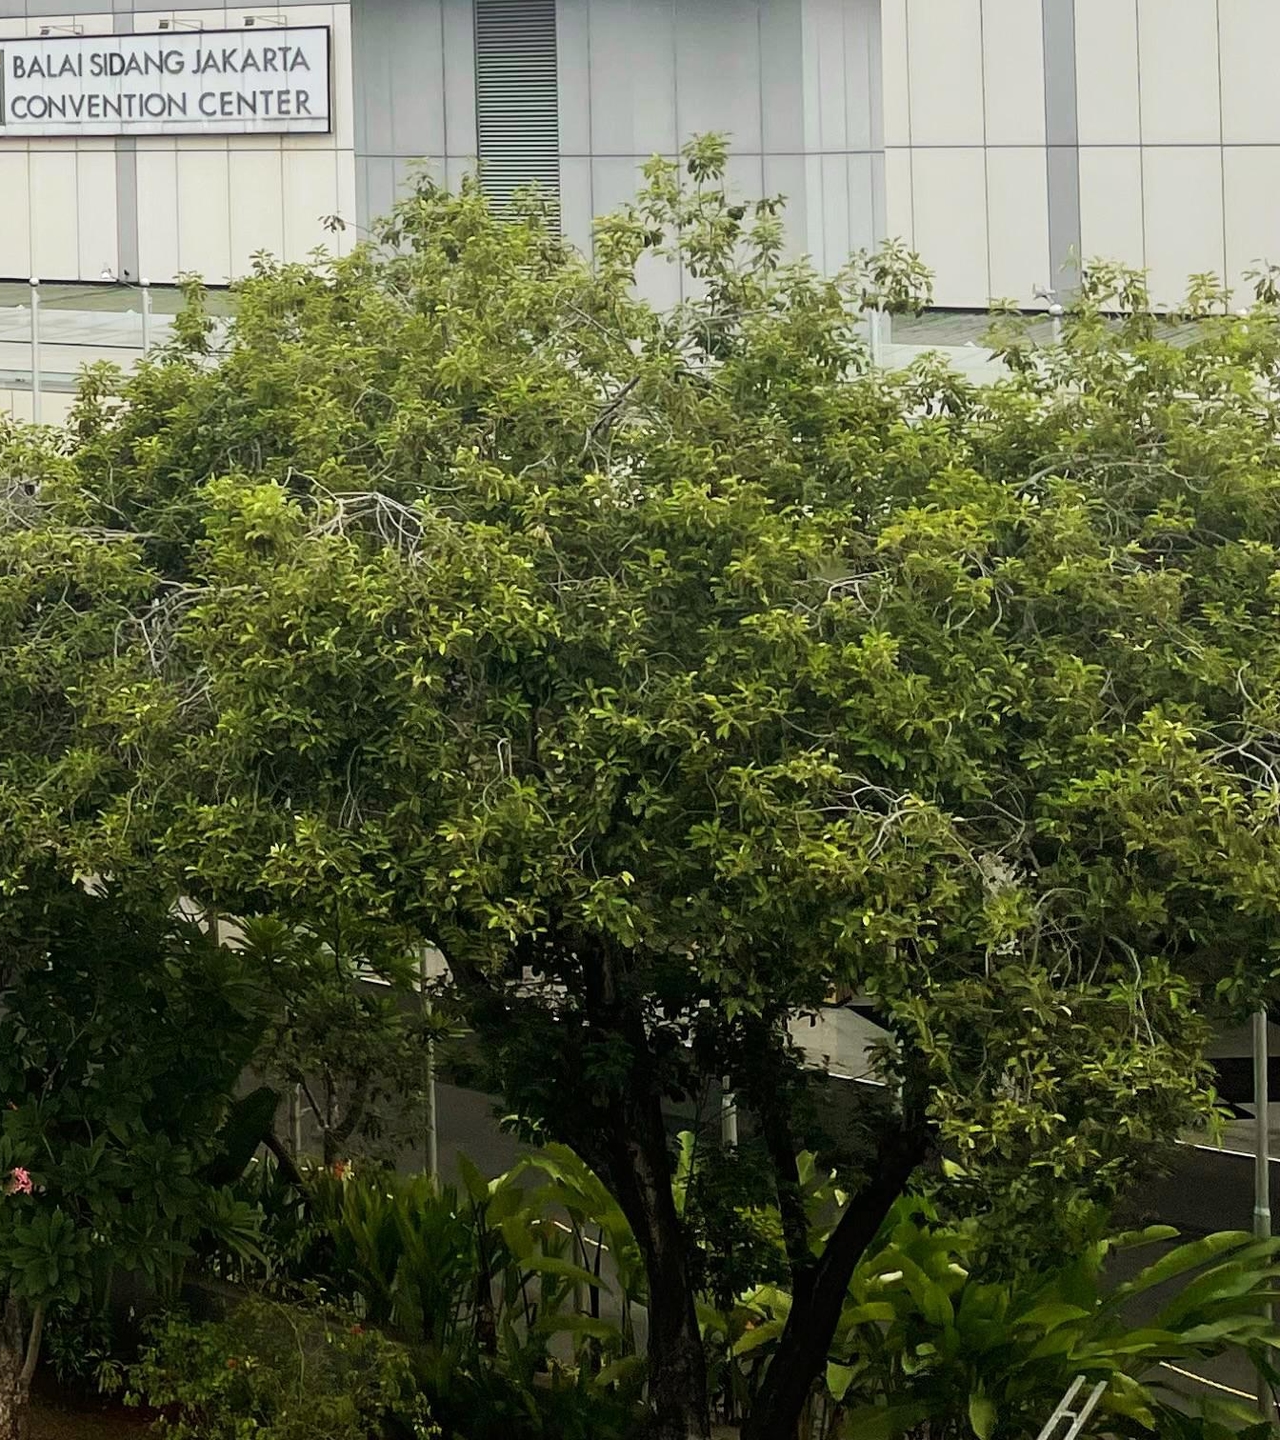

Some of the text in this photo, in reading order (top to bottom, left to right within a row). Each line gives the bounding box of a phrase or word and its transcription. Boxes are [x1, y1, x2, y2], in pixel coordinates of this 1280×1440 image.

[12, 46, 311, 79] BALAI SIDANG JAKARTA
[10, 89, 312, 119] CONVENTION CENTER
